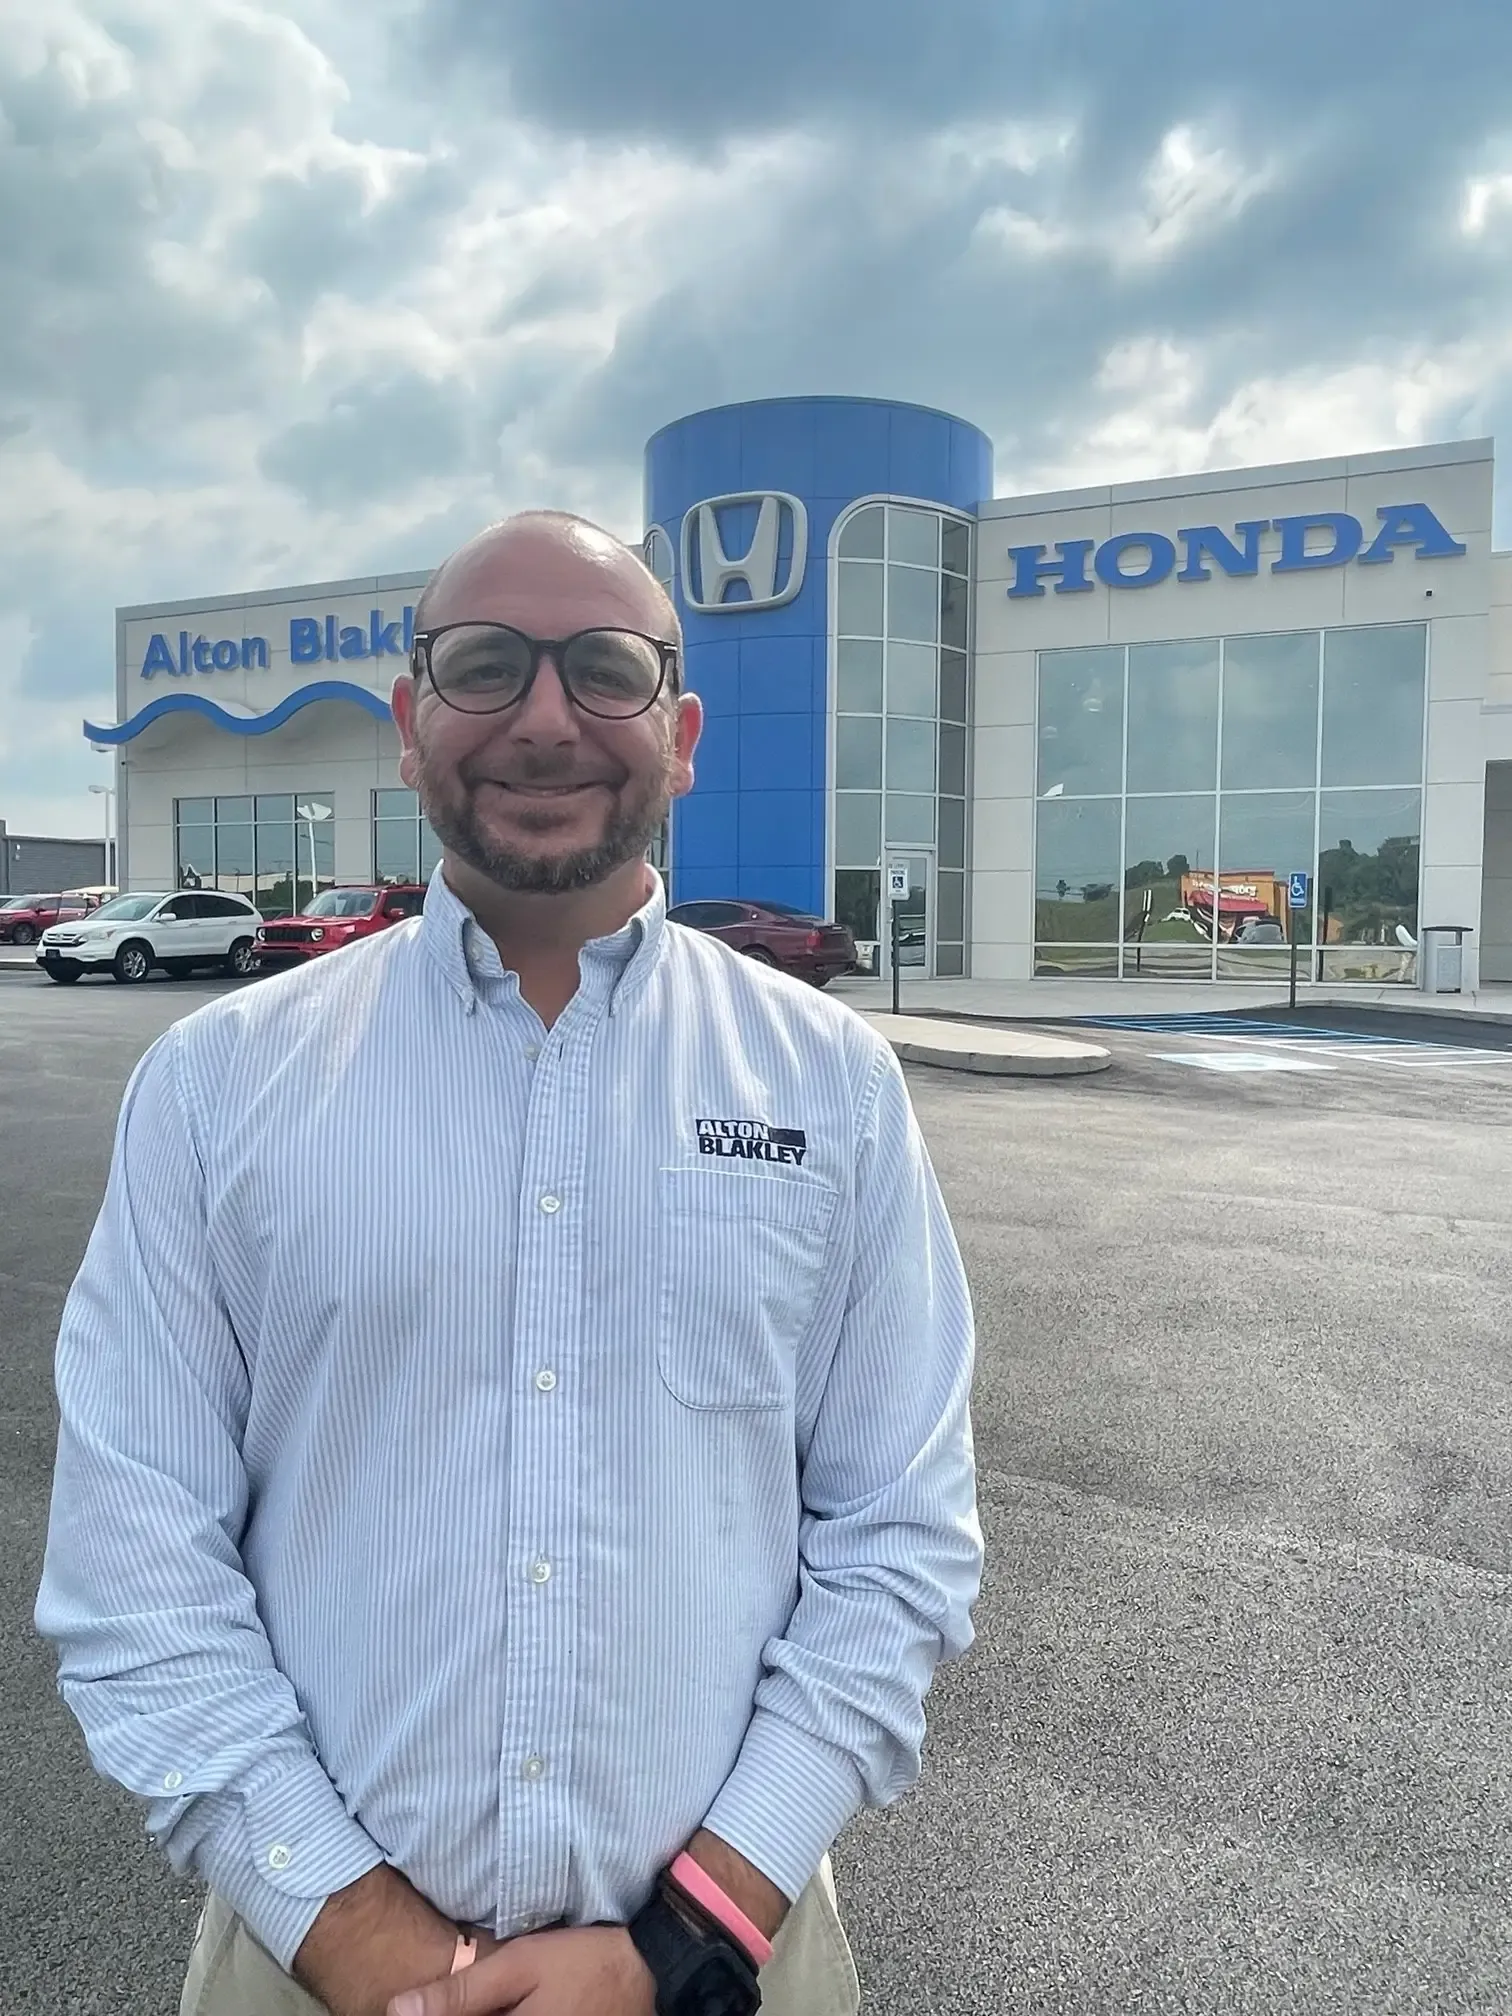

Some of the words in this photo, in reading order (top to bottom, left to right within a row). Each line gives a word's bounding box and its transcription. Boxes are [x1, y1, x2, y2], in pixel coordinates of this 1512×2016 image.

[1006, 502, 1467, 598] HONDA
[140, 631, 269, 679] Alton
[698, 1120, 769, 1140] ALTON
[699, 1138, 806, 1166] BLAKLEY
